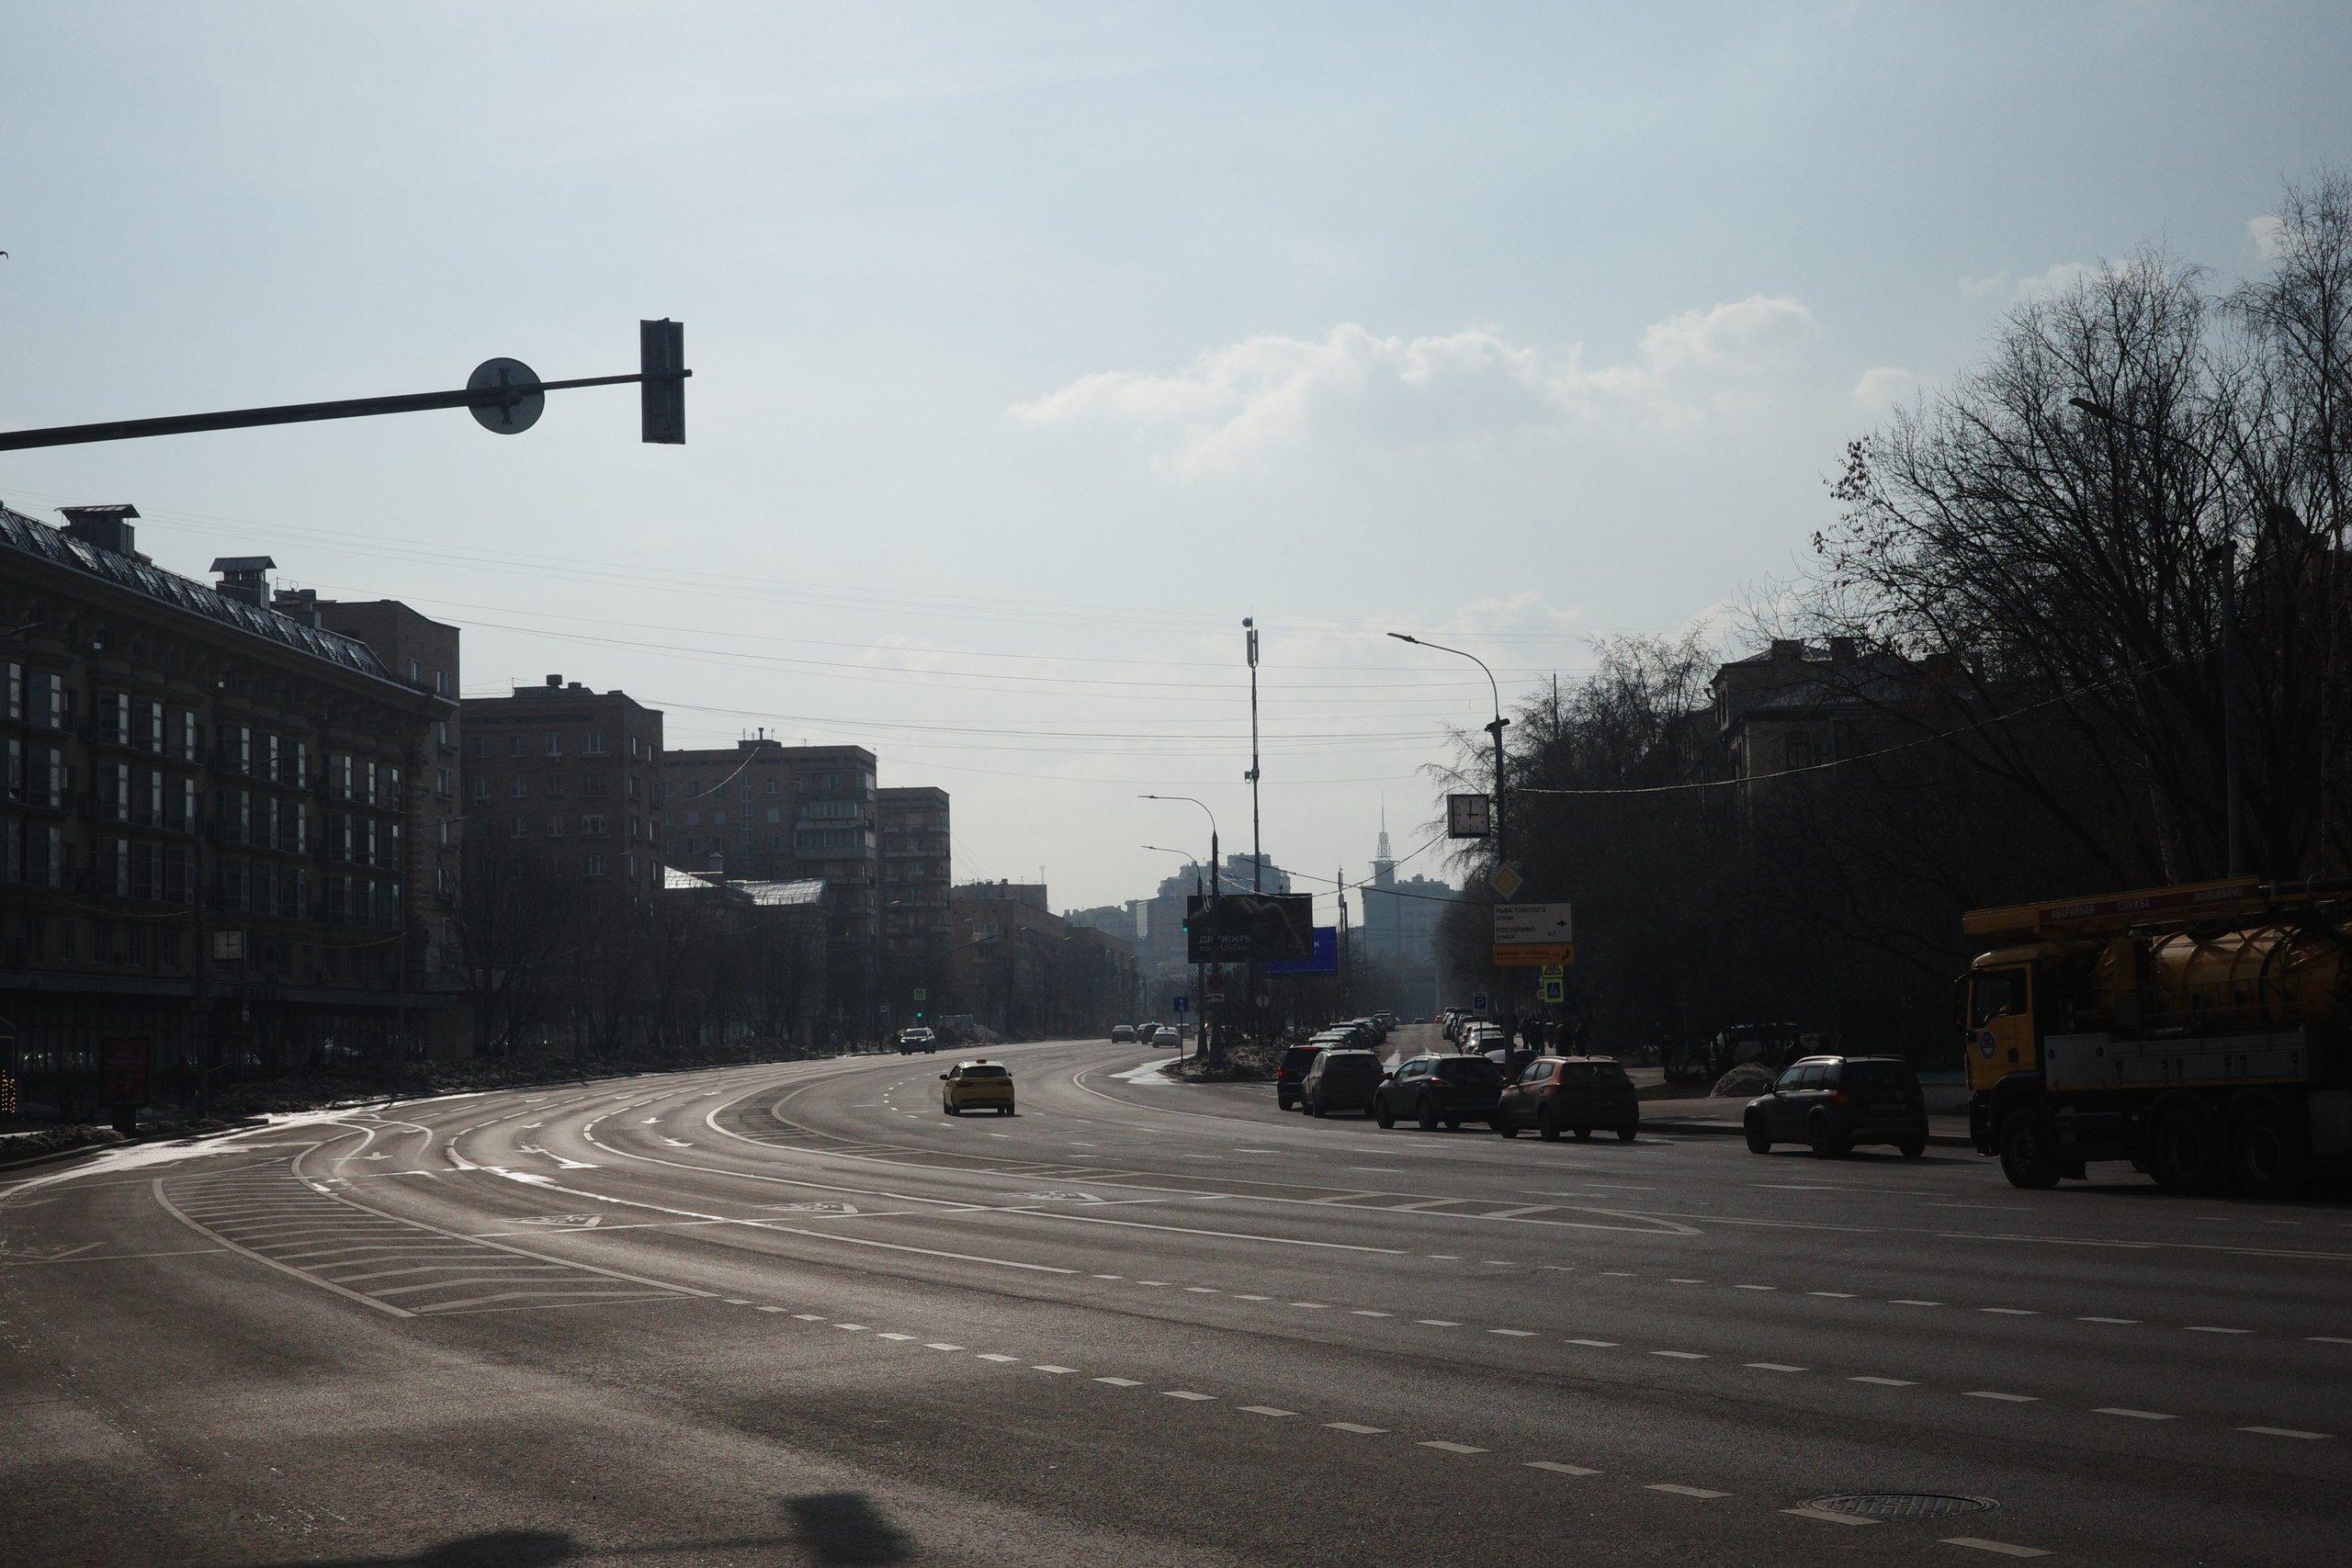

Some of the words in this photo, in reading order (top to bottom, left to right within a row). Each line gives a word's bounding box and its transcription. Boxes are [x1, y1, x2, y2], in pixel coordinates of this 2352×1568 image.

[2051, 904, 2095, 919] АВАРИЙНАЯ
[2117, 897, 2150, 911] СЛУЖБА
[1199, 935, 1251, 944] ДРЖИТЬ
